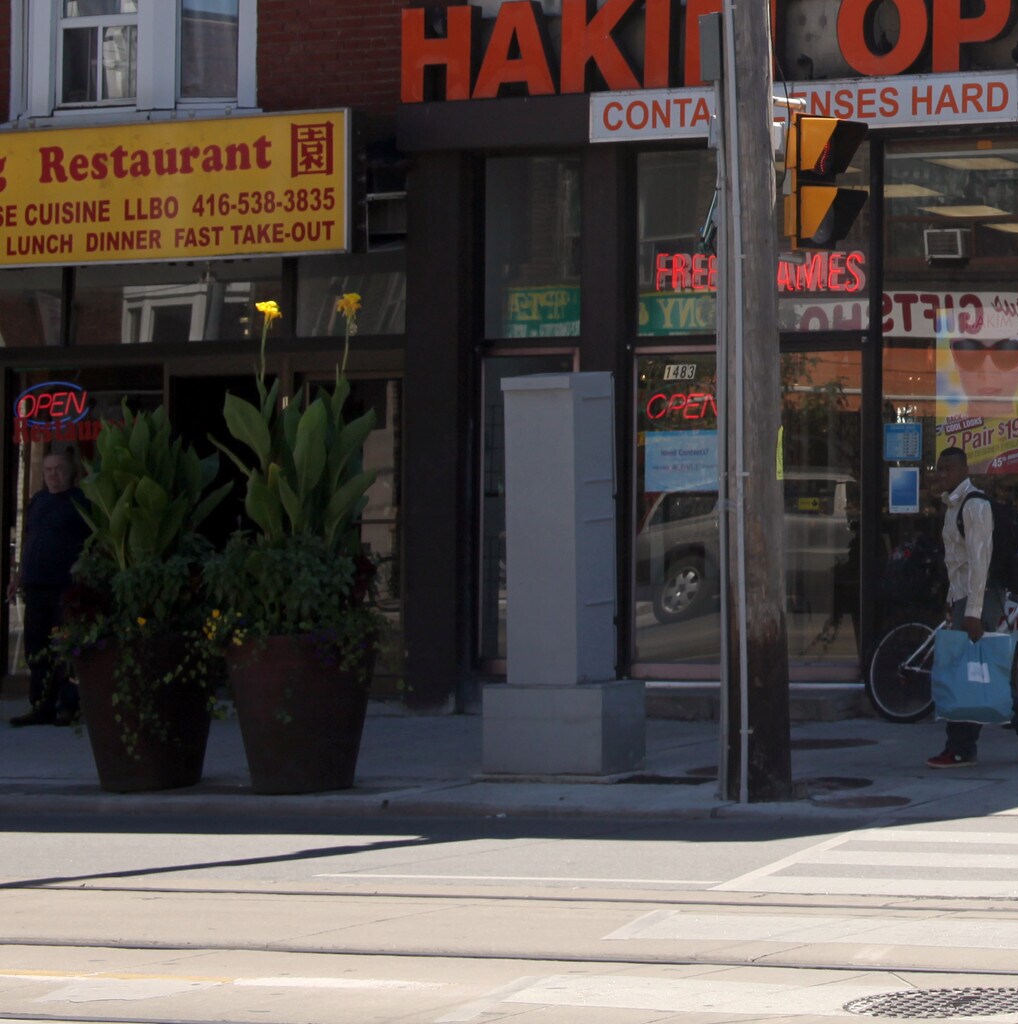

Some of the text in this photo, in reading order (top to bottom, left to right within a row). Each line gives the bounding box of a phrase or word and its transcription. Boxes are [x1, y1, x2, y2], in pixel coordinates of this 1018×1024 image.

[603, 97, 711, 131] CONTA
[910, 80, 1009, 116] HARD
[38, 135, 273, 184] Restaurant
[290, 120, 335, 179] 園
[25, 200, 111, 226] CUISINE
[123, 195, 179, 222] LLBO
[192, 187, 336, 217] 416-538-3835
[6, 220, 335, 256] LUNCH DINNER FAST TAKE-OUT
[777, 253, 866, 293] AMES
[666, 365, 695, 379] 1483
[17, 391, 87, 417] OPEN
[646, 393, 718, 419] OPEN
[962, 426, 994, 451] Pair
